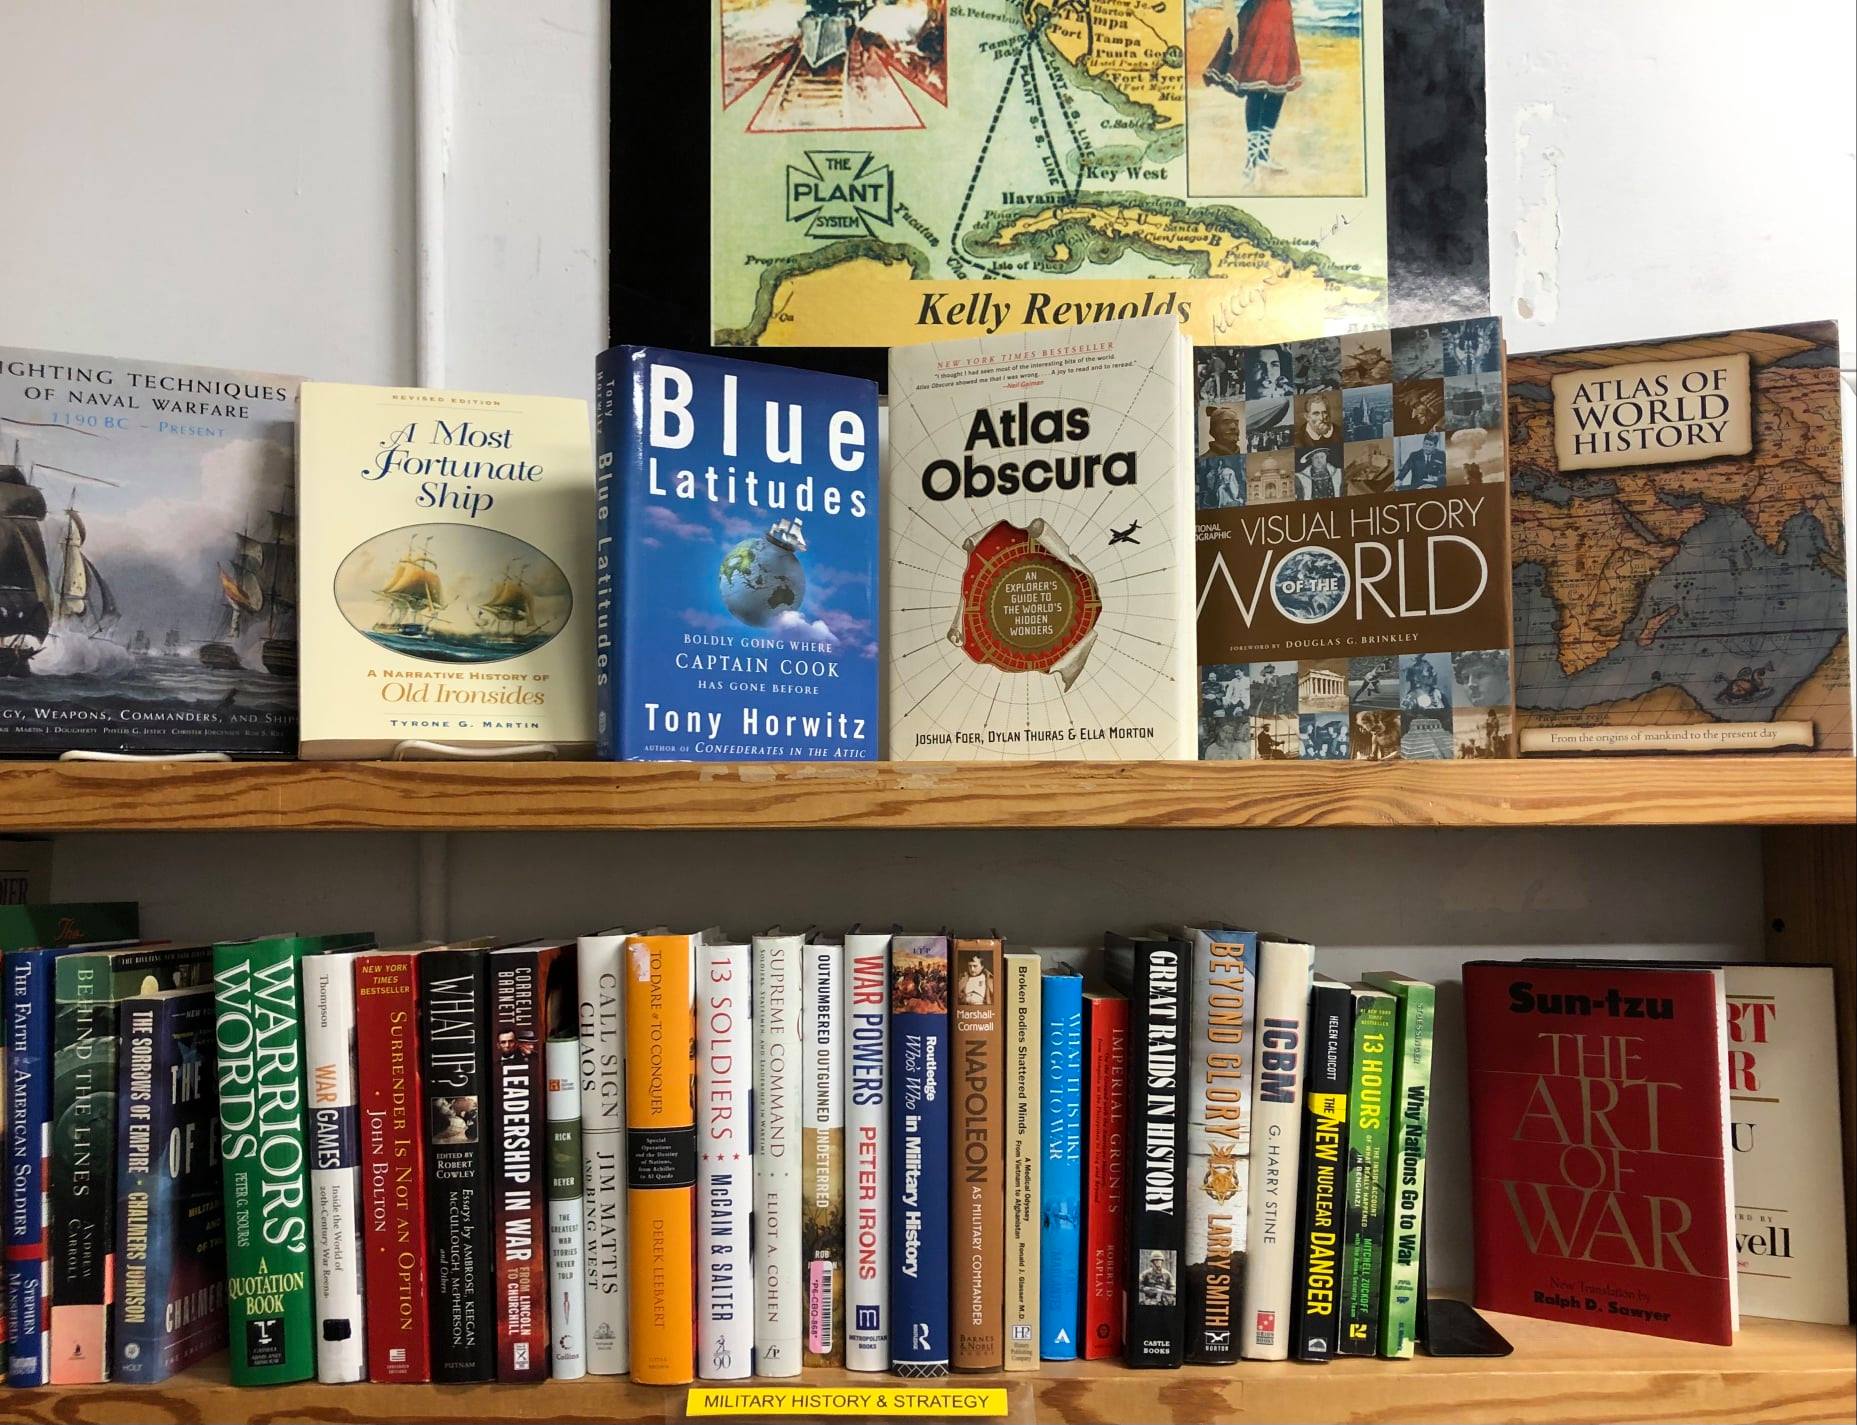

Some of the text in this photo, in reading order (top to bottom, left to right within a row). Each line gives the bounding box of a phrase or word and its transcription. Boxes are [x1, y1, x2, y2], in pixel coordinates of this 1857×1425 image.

[1050, 24, 1141, 46] Port Tampa
[826, 158, 852, 170] THE
[1085, 166, 1168, 181] Key West
[793, 183, 884, 202] PLANT
[816, 216, 859, 228] SYSTEM
[915, 292, 1011, 334] Kelly
[1021, 291, 1192, 325] Reynolds
[24, 387, 249, 418] OF NAVAL WARFARE
[127, 372, 287, 401] TECHNIQUES
[1572, 369, 1727, 404] ATLAS OF
[1572, 393, 1729, 431] WORLD
[428, 420, 513, 449] Most
[650, 364, 865, 471] Blue
[964, 402, 1090, 451] Atlas
[1574, 421, 1729, 455] HISTORY
[361, 444, 543, 481] Fortunate
[650, 457, 866, 518] Latitudes
[922, 452, 1137, 501] Obscura
[416, 481, 493, 518] Ship
[1241, 497, 1485, 546] VISUAL HISTORY
[1005, 581, 1058, 592] EXPLORER'S
[1022, 602, 1062, 613] WORLD'S
[1010, 625, 1053, 636] WONDERS
[1015, 615, 1048, 625] HIDDEN
[1361, 633, 1419, 644] BRINKLEY
[676, 653, 839, 677] CAPTAIN COOK
[35, 708, 223, 723] WEAPONS, COMMANDERS,
[381, 682, 545, 705] Old Ironsides
[483, 721, 539, 729] MARTIN
[645, 704, 865, 739] Tony Horwitz
[915, 727, 1154, 746] JOSHUA DYLAN THURAS ELLA MORTON
[1551, 728, 1777, 744] From the origins mankind the present day
[318, 974, 330, 1028] Thompson
[360, 985, 410, 995] BESTSELLER
[497, 971, 517, 1023] BARNETT
[515, 967, 533, 1027] CORRELLI
[957, 1009, 995, 1020] Marshall-
[1508, 981, 1675, 1020] Sun-tzu
[429, 974, 476, 1088] WHAT IF?
[580, 1002, 597, 1092] CHAOS
[600, 973, 619, 1119] CALL SIGN
[709, 958, 733, 1140] 13 SOLDIERS
[851, 955, 883, 1105] WAR POWERS
[957, 1020, 994, 1032] Cornwall
[1017, 966, 1028, 1135] Broken Bodies Shattered Minds
[1205, 942, 1244, 1139] BEYOND GLORY
[1326, 1015, 1340, 1080] HELEN CALDICOTT
[213, 959, 257, 1160] WORDS
[769, 949, 786, 1159] SUPREME COMMAND
[924, 1036, 938, 1101] Routledge
[1260, 1018, 1299, 1104] ICBM
[1539, 1032, 1648, 1084] THE
[72, 970, 95, 1197] BEHIND LINES
[251, 955, 306, 1254] WARRIORS'
[648, 1044, 664, 1116] CONQUER
[815, 954, 831, 1208] OUTNUMBERED OUTGUNNED UNDETERRED
[1145, 951, 1178, 1216] GREAT RAIDS IN HISTORY
[1359, 1033, 1384, 1130] 13 HOURS
[1405, 1086, 1424, 1121] Why
[12, 1002, 32, 1236] FAITH AMERICAN SOLDIER
[315, 1064, 341, 1169] WAR GAMES
[965, 1039, 988, 1182] NAPOLEON
[1512, 1075, 1683, 1154] ART
[124, 1011, 154, 1324] THE SORROWS EMPIRE CHALMERS JOHNSON
[366, 1109, 389, 1233] JOHN BOLTON
[390, 1011, 415, 1332] SURRENDER OPTION
[436, 1169, 475, 1179] COWLEY
[437, 1160, 473, 1170] ROBERT
[503, 1064, 532, 1260] LEADERSHIP WAR
[902, 1035, 921, 1278] Who's Who in Military History
[1402, 1124, 1424, 1185] Nations
[1559, 1143, 1636, 1194] OF
[597, 1151, 619, 1295] JIM MATTIS
[858, 1126, 877, 1280] PETER IRONS
[1307, 1117, 1339, 1315] NEW NUCLEAR DANGER
[1399, 1214, 1417, 1229] to
[1401, 1190, 1418, 1211] Go
[709, 1173, 733, 1322] McCAIN SALTER
[1398, 1234, 1417, 1266] War
[1501, 1179, 1700, 1277] WAR
[227, 1273, 304, 1291] QUOTATION
[971, 1205, 983, 1326] MILITARY COMMANDER
[1205, 1214, 1233, 1327] LARRY SMITH
[246, 1298, 284, 1313] BOOK
[652, 1263, 665, 1329] LEEBAERT
[704, 1395, 990, 1408] MILITARY HISTORY & STRATEGY
